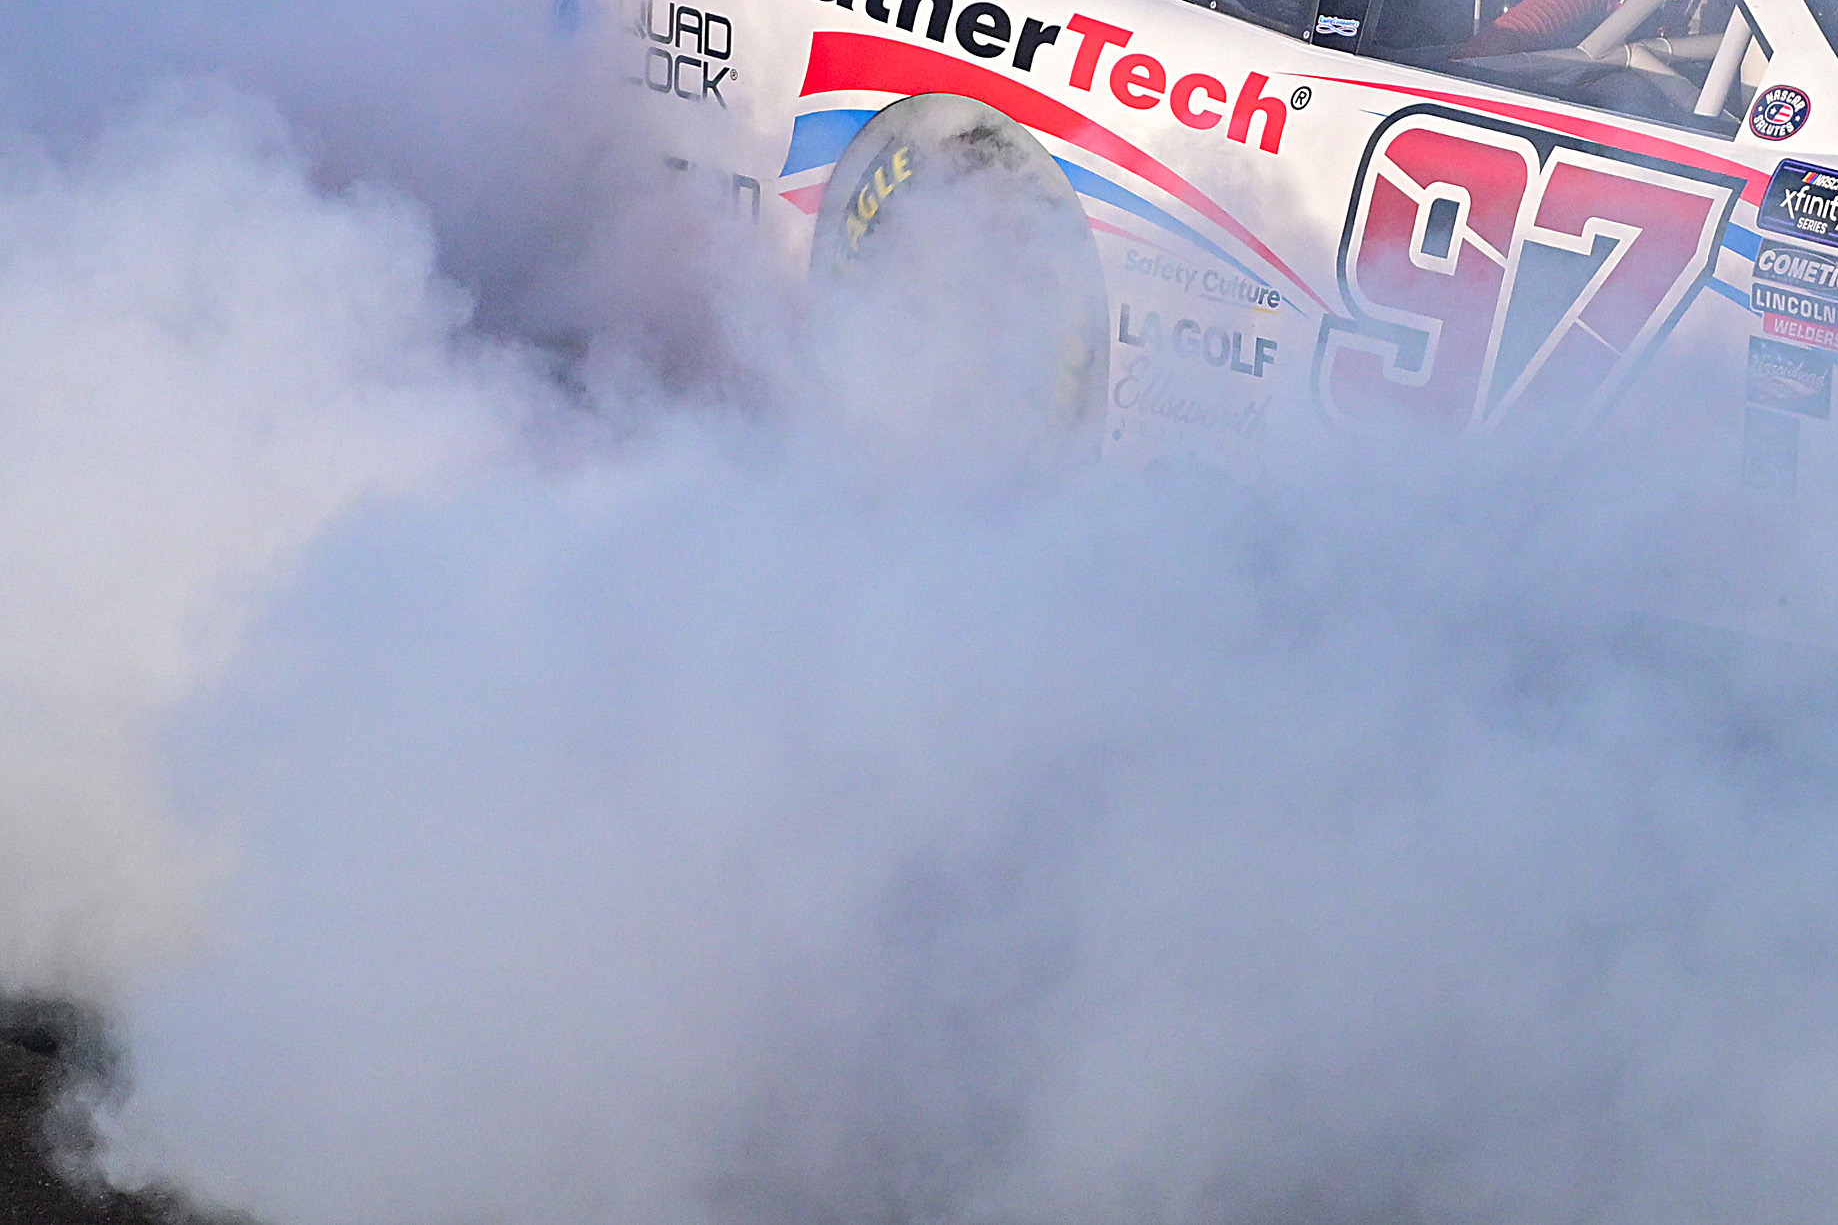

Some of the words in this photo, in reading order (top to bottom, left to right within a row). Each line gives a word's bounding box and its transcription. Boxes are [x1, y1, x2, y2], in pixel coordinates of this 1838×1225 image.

[1765, 89, 1806, 112] NASCAR
[1753, 113, 1795, 137] SALUTES
[1797, 217, 1828, 234] SERIES
[1312, 103, 1747, 435] 97
[1756, 289, 1837, 324] LINCOLN
[1174, 318, 1278, 378] GOLF
